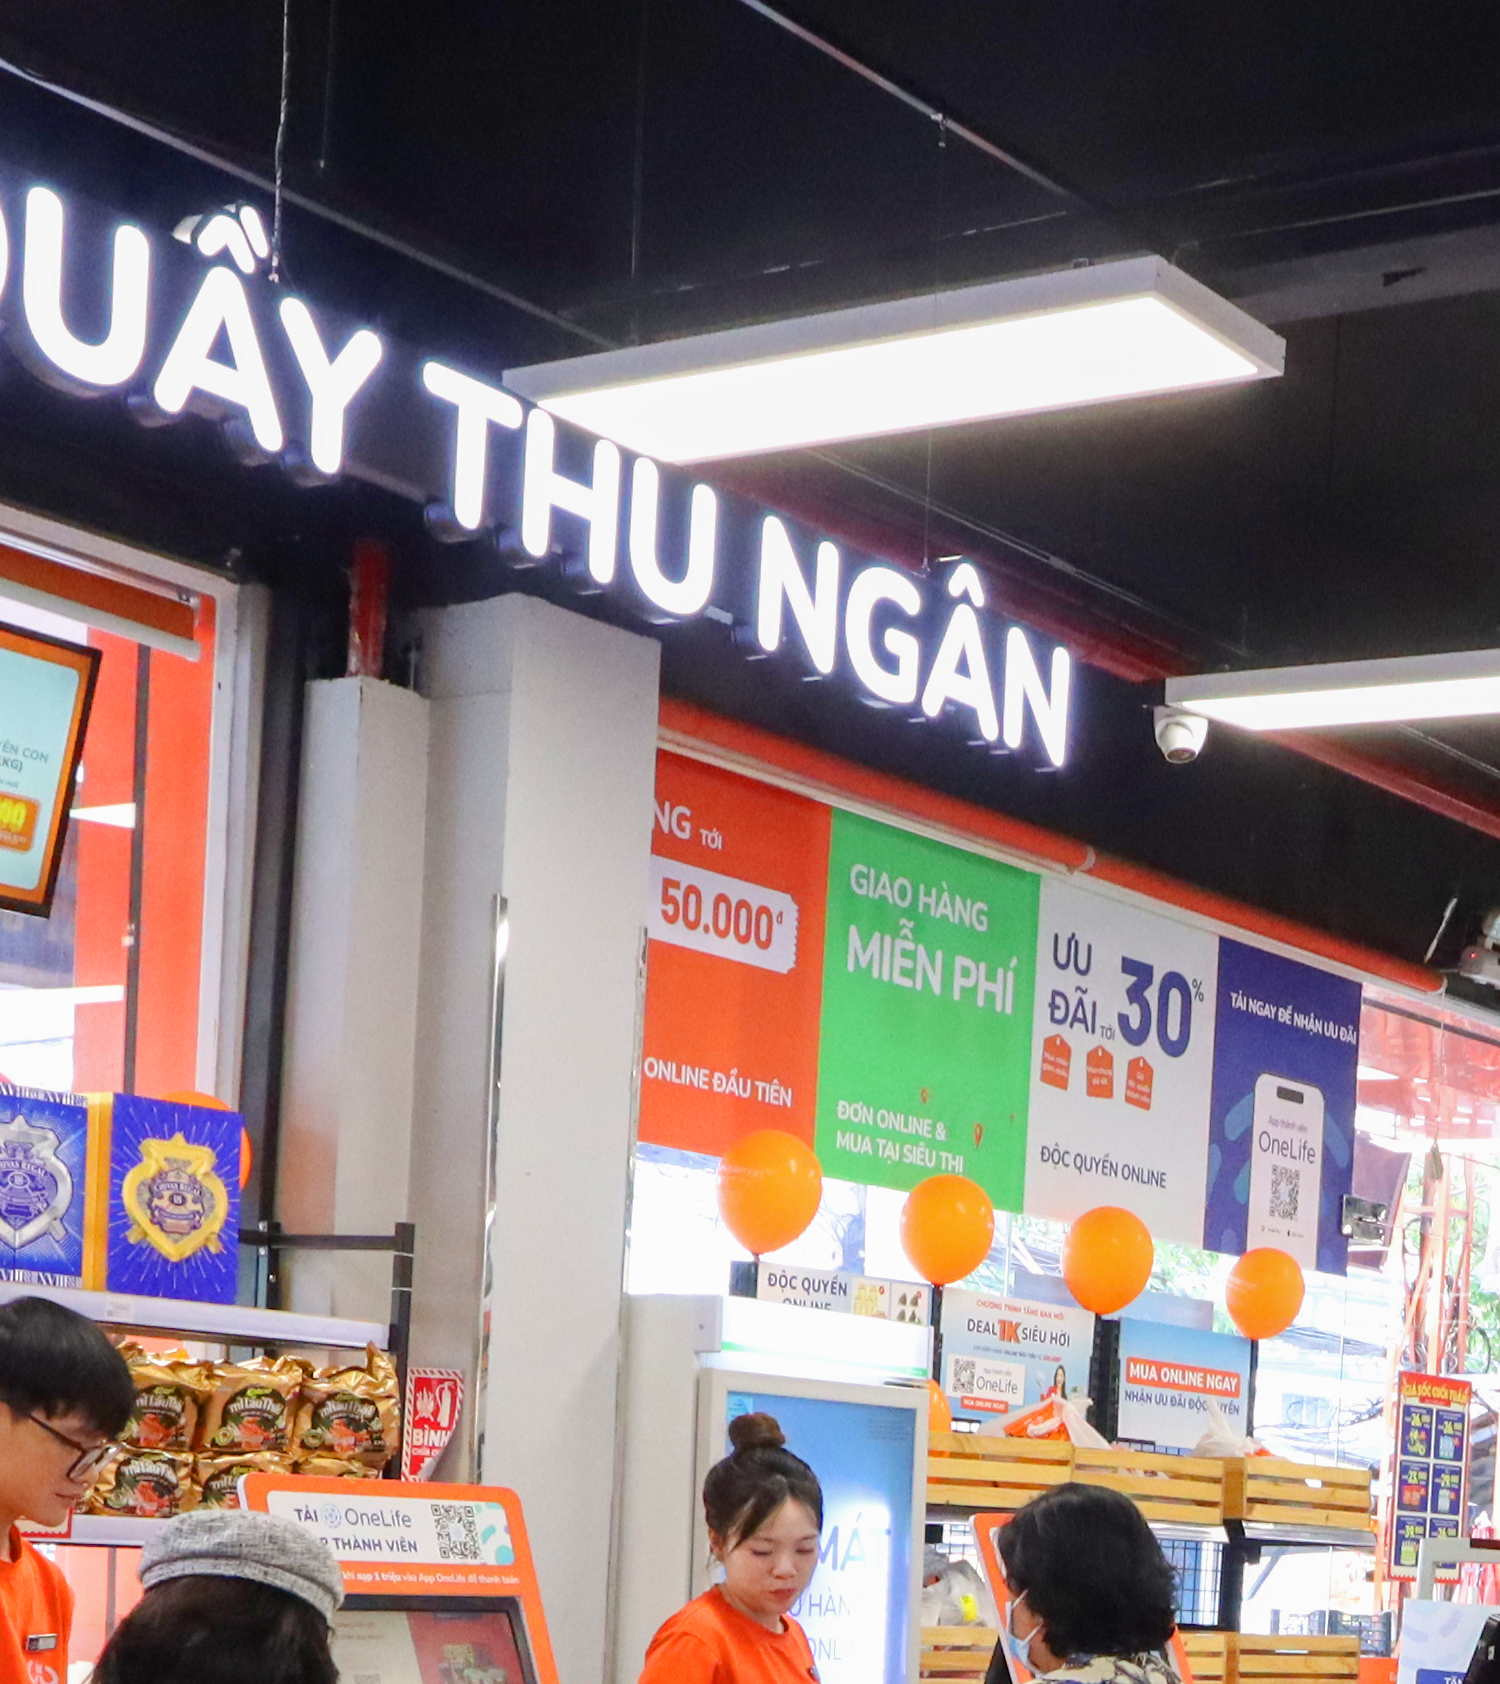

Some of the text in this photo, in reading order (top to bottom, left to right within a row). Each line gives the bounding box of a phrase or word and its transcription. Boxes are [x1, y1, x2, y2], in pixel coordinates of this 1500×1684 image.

[422, 362, 718, 616] THU
[760, 512, 1072, 768] NGÂN
[849, 863, 989, 932] GIAO HÀNG
[847, 918, 1018, 1015] MIỄN PHÍ
[1053, 932, 1092, 977] ƯU
[1048, 986, 1096, 1035] ĐÃI
[1229, 990, 1357, 1045] TẢI NGAY ĐỂ ƯU ĐÃI
[644, 1056, 793, 1109] ONLINE ĐẦU TIÊN
[836, 1099, 932, 1139] ĐƠN ONLINE
[835, 1130, 937, 1168] MUA TẠI SIÊU
[1041, 1142, 1167, 1190] ĐỘC QUYỀN ONLINE
[1258, 1131, 1316, 1164] OneLife
[767, 1270, 848, 1297] ĐỘC QUYỀN
[967, 1319, 1070, 1348] DEAL SIÊU HỜI
[976, 1376, 1018, 1395] OneLife
[1130, 1362, 1238, 1392] MUA ONLINE NGAY
[294, 1503, 412, 1528] TẢI OneLife
[332, 1535, 418, 1553] THÀNH VIÊN
